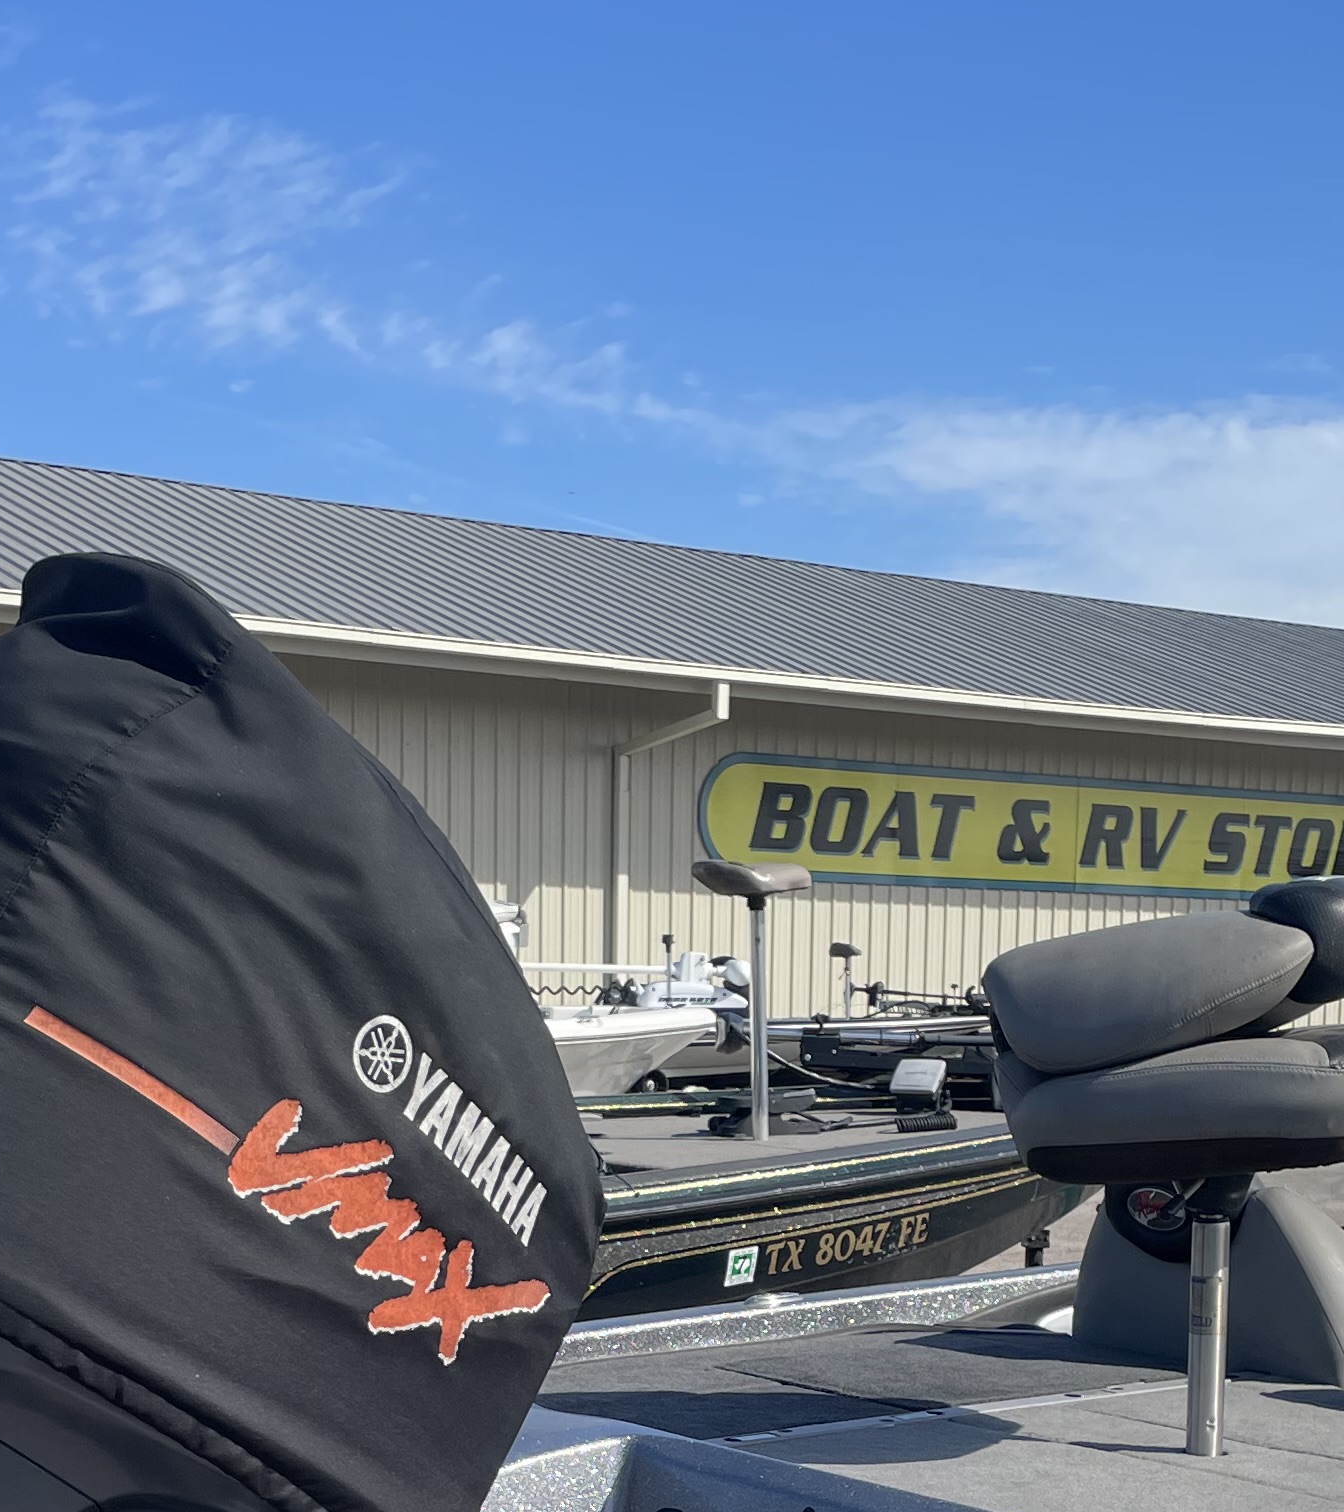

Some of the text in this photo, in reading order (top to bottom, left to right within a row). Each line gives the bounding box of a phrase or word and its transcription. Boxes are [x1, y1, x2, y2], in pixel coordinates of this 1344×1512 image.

[749, 782, 976, 862] BOAT
[997, 798, 1051, 867] &
[1079, 803, 1188, 872] RV
[403, 1052, 548, 1248] YAMAHA
[765, 1211, 931, 1276] TX 8047 FE
